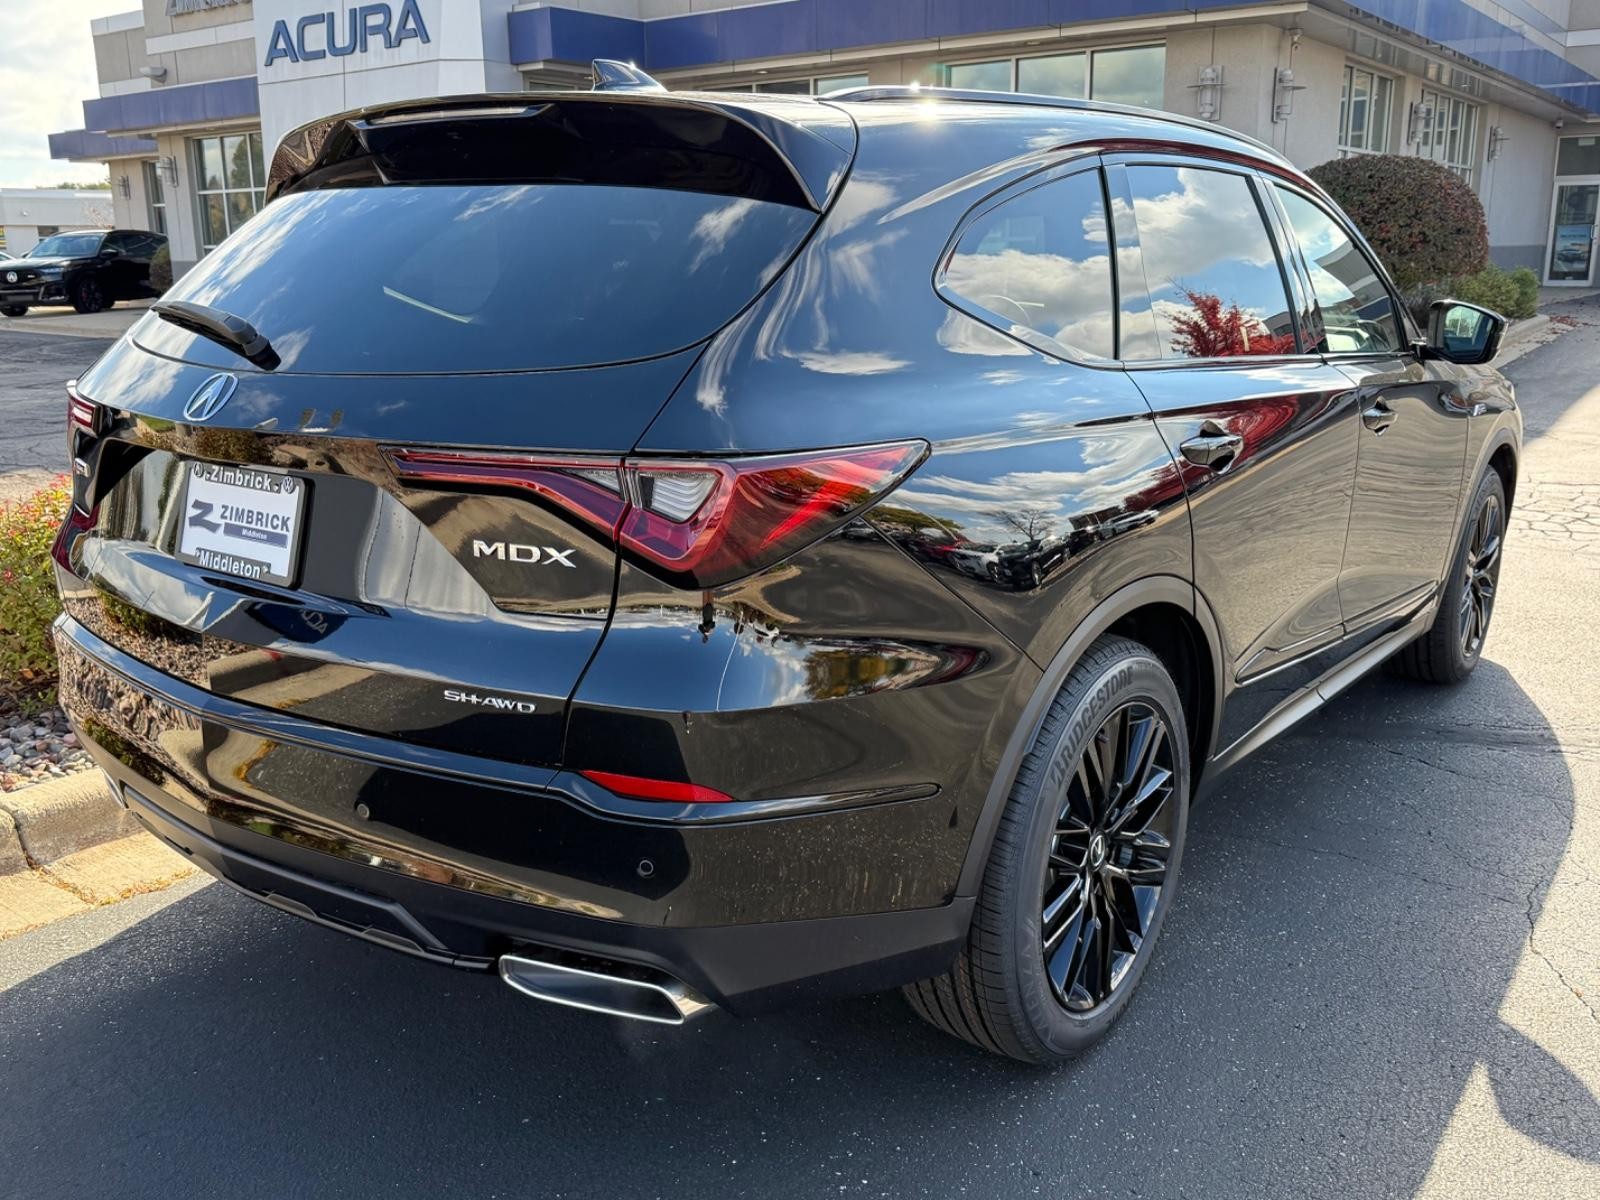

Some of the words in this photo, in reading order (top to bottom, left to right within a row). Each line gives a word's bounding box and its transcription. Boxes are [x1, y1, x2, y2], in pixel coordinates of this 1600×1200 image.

[264, 0, 431, 66] ACURA
[211, 465, 271, 491] Zimbrick
[220, 504, 291, 532] ZIMBRICK
[241, 528, 268, 540] Middleton
[199, 549, 261, 578] Middleton
[473, 539, 577, 568] MDX
[443, 689, 537, 713] SH-AWD
